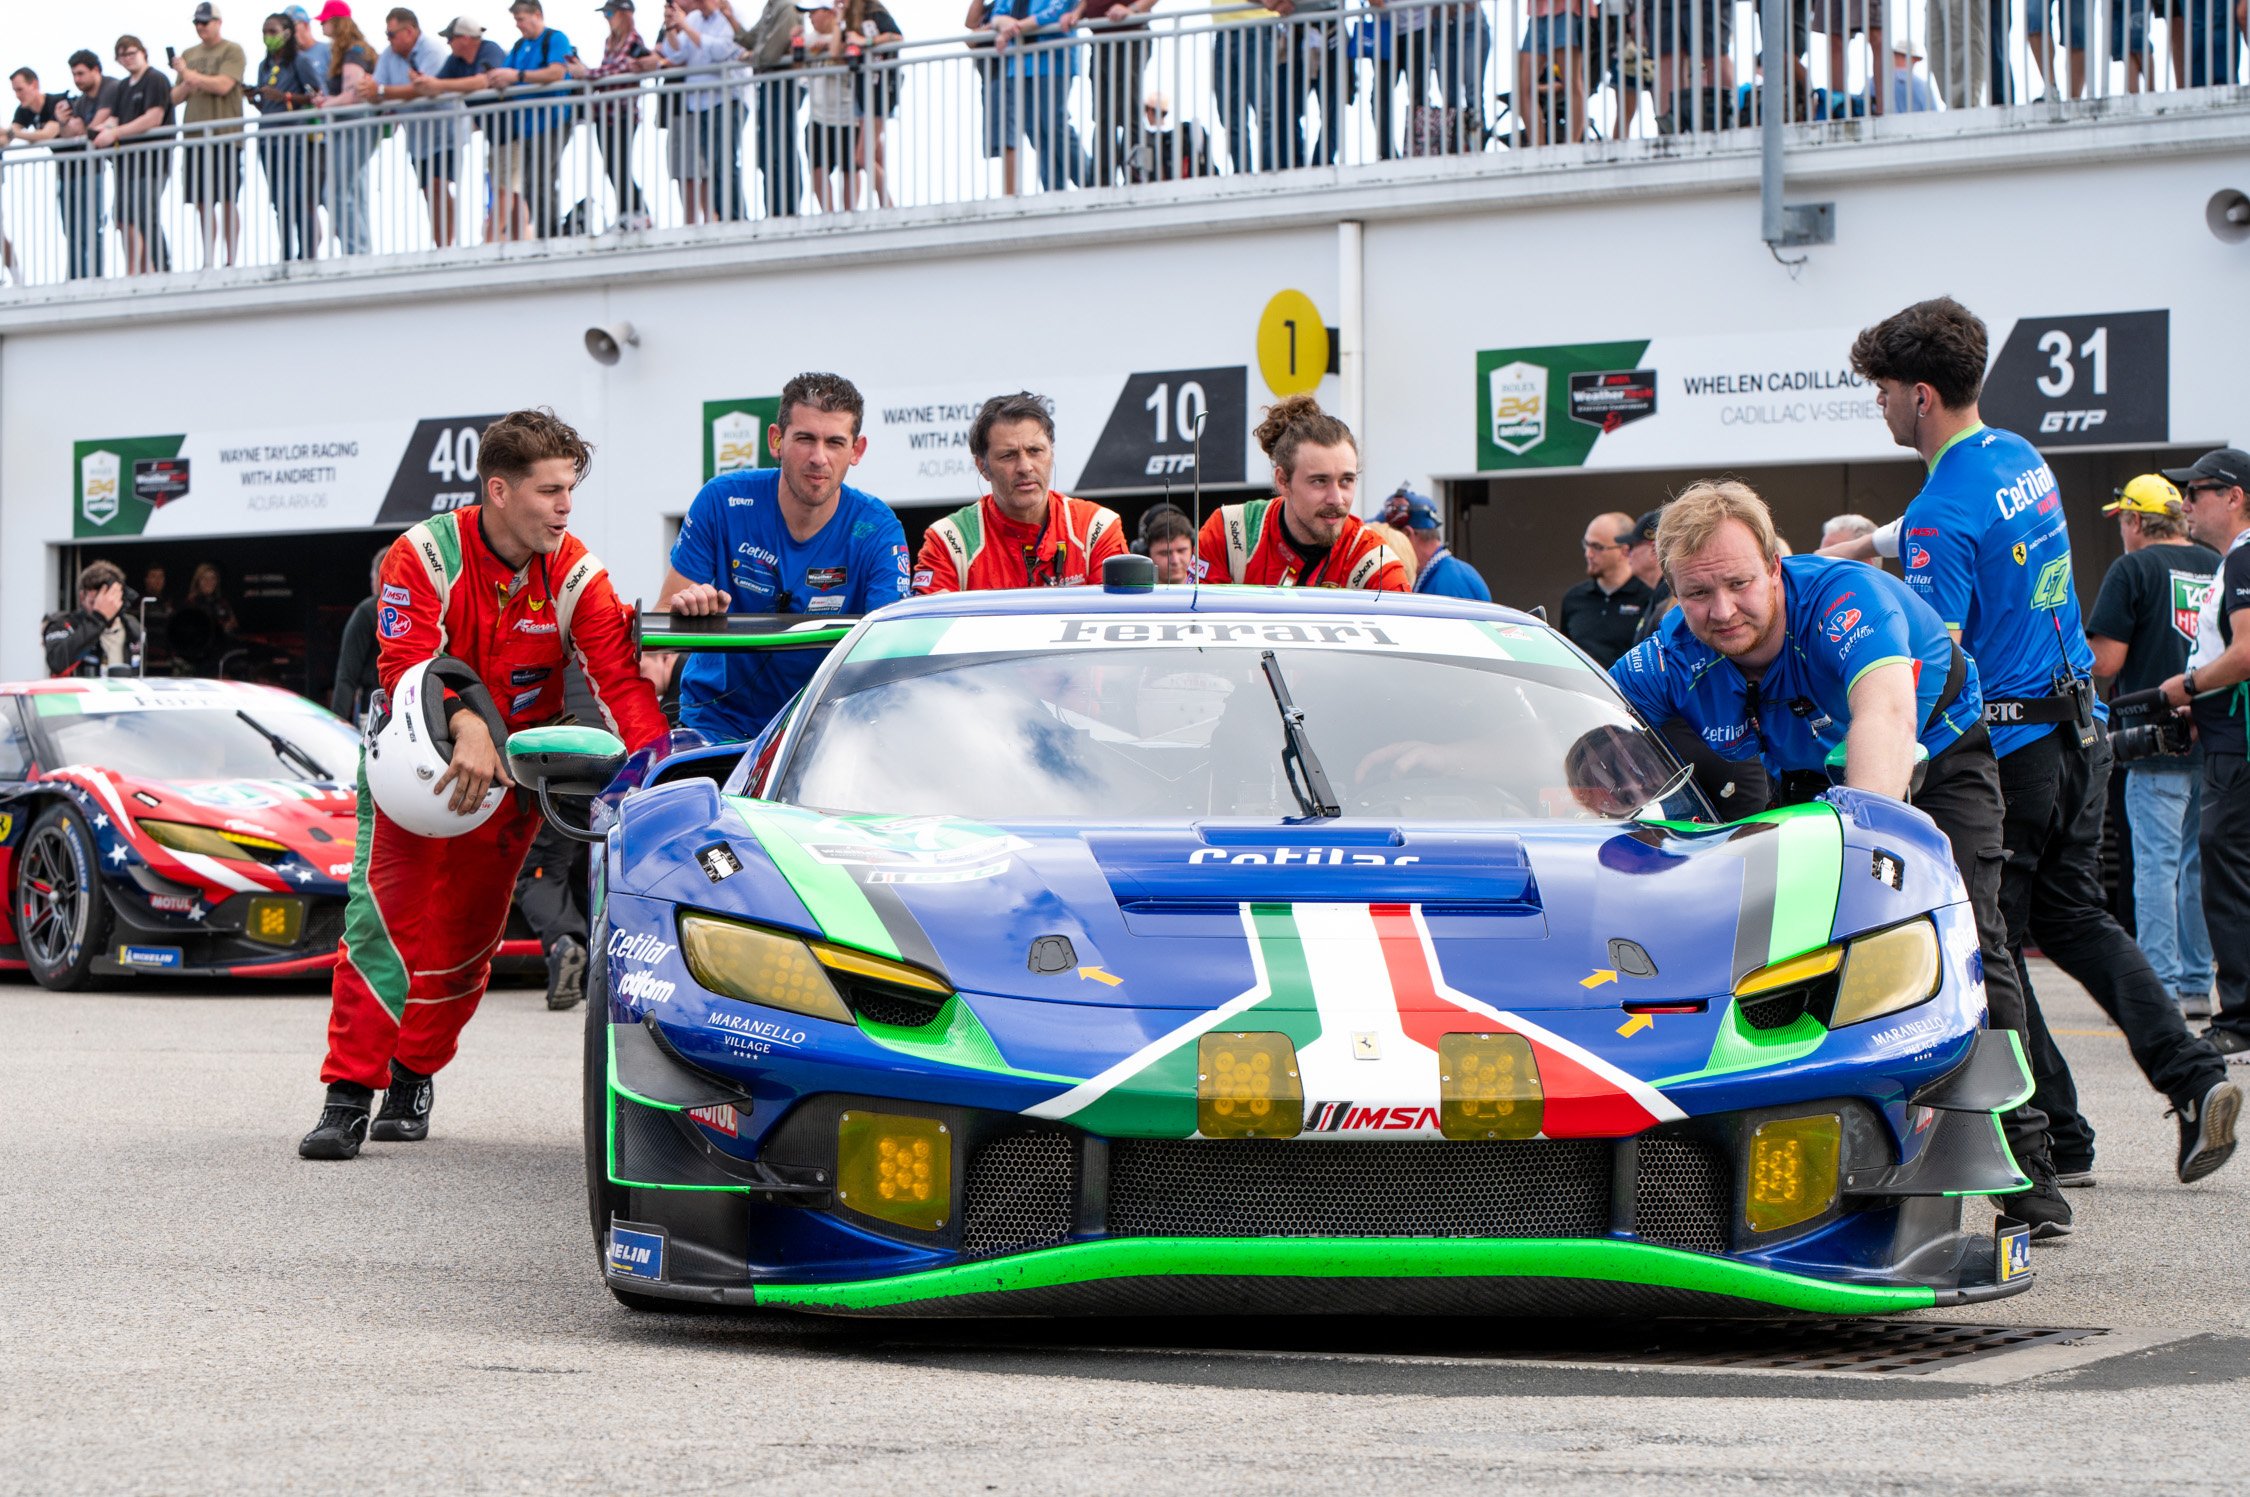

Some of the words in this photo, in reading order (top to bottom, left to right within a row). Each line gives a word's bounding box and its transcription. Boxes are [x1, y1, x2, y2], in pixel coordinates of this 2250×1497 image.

[1283, 319, 1296, 376] 1
[2036, 326, 2108, 398] 31
[1683, 374, 1763, 395] WHELEN
[1767, 369, 1863, 392] CADILLAC
[882, 405, 934, 425] WAYNE
[937, 403, 982, 422] TAYLO
[1145, 381, 1207, 443] 10
[1497, 394, 1540, 419] 24
[1720, 403, 1806, 426] CADILLAC
[2039, 409, 2108, 433] GTP
[219, 446, 261, 464] WAYNE
[264, 444, 311, 462] TAYLOR
[311, 441, 360, 459] RACING
[719, 441, 753, 461] 24
[909, 433, 948, 450] WITH
[428, 427, 481, 482] 40
[918, 457, 966, 477] ACURA
[1145, 453, 1196, 475] GTP
[240, 468, 273, 486] WITH
[275, 466, 337, 484] ANDRETTI
[431, 491, 476, 512] GTP
[943, 529, 962, 555] Sabelt
[1230, 520, 1243, 551] Sabelt
[423, 541, 444, 573] Sabelt
[566, 564, 589, 593] Sabelt
[1352, 558, 1375, 588] Sabelt
[1049, 619, 1401, 647] Ferrari
[151, 895, 192, 910] MOTUL
[607, 928, 677, 965] Cetilar
[707, 1012, 806, 1045] MARANELLO
[1871, 1015, 1945, 1046] MARANELLO
[723, 1035, 772, 1055] VILLAGE
[1903, 1038, 1938, 1055] VILLAGE
[1340, 1106, 1442, 1131] IMSA
